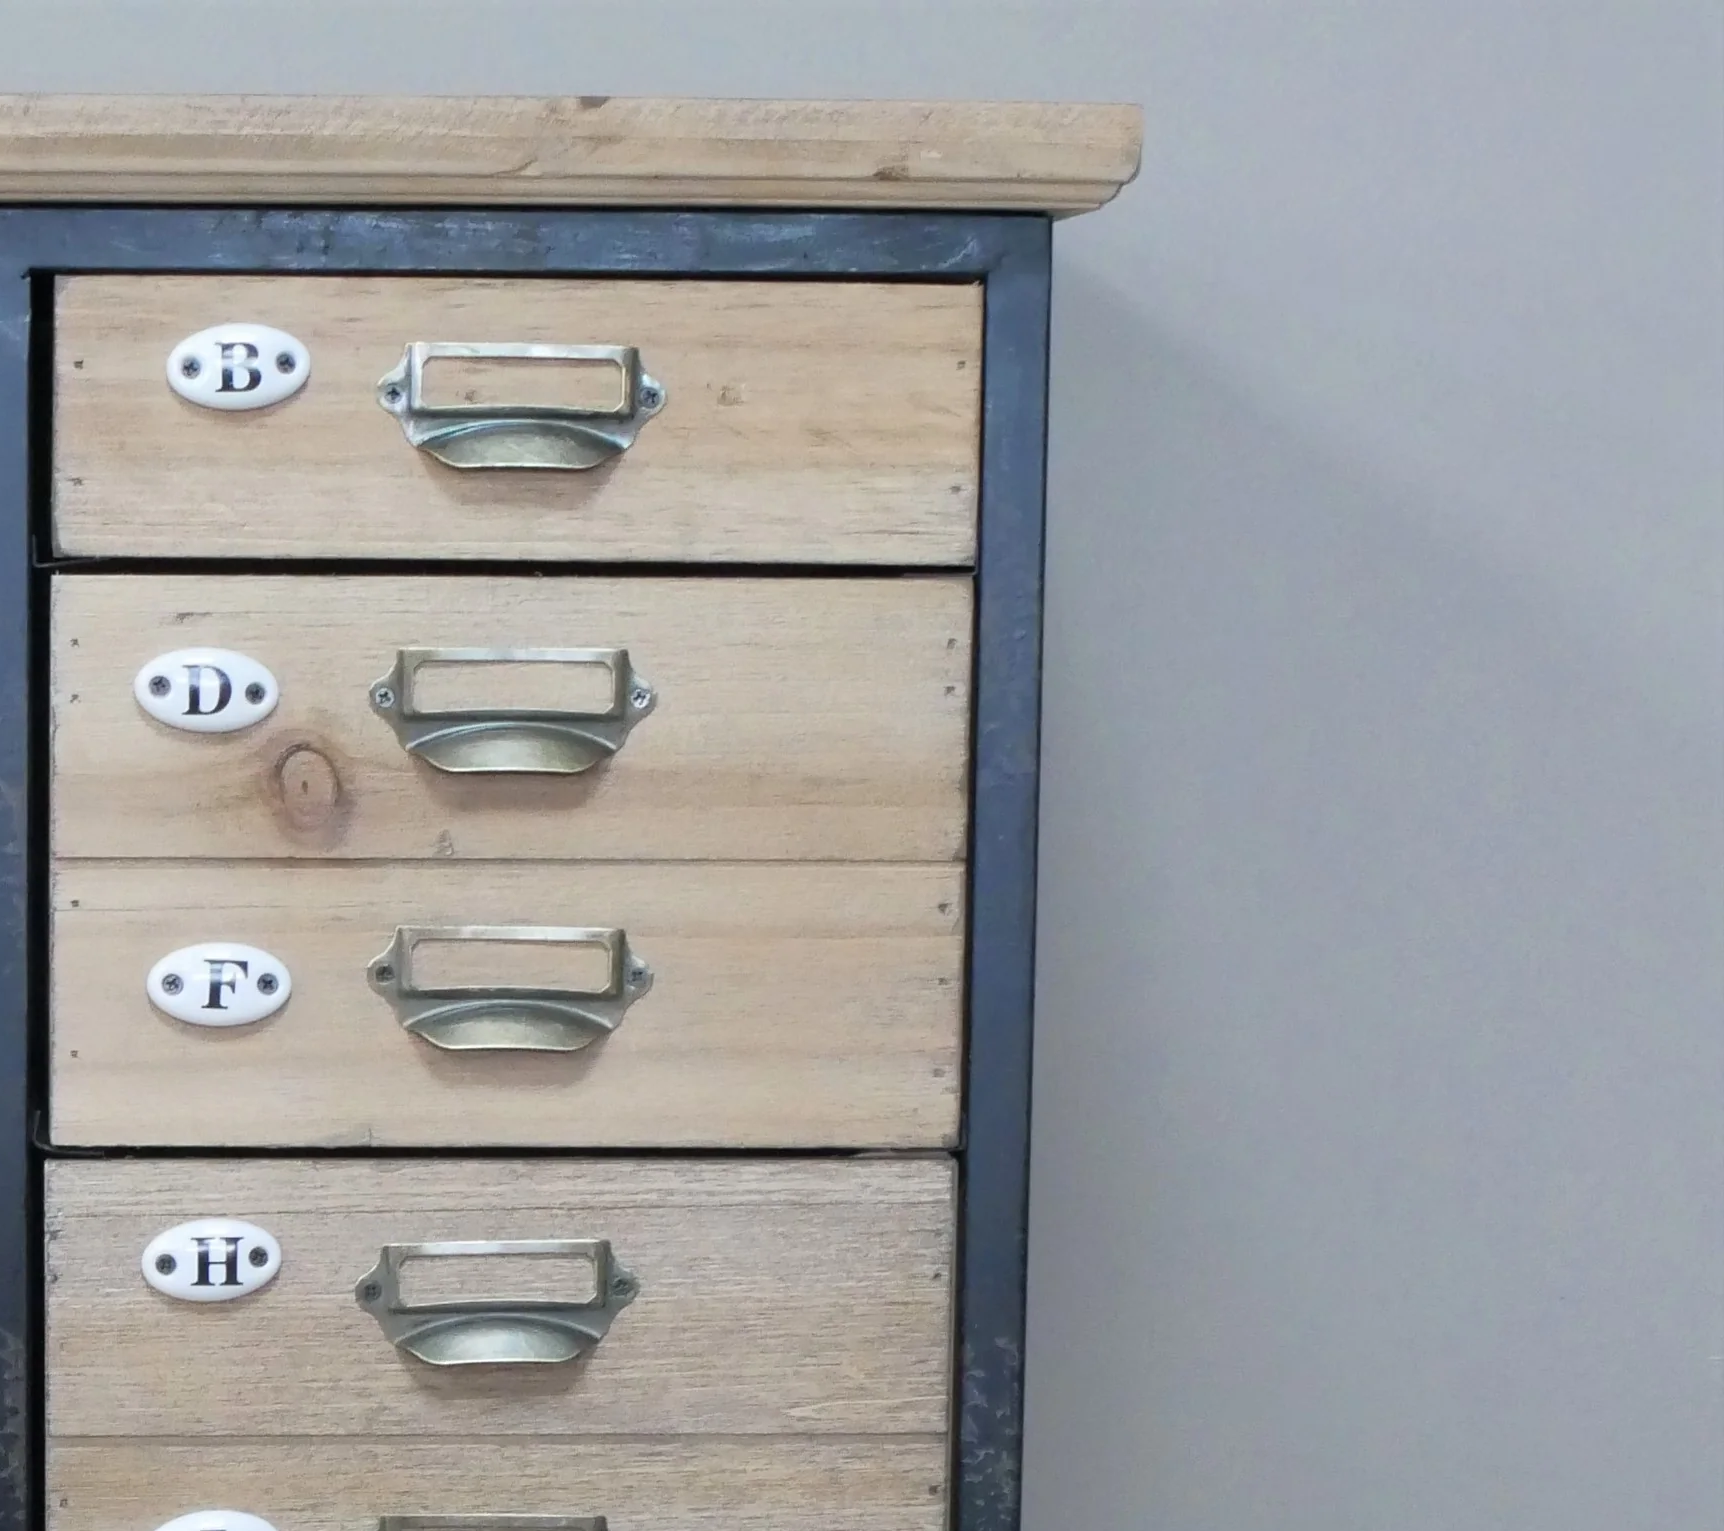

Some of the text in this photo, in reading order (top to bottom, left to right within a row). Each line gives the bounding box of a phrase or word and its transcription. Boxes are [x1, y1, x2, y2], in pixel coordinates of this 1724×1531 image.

[215, 341, 262, 393] B
[181, 664, 232, 715] D
[201, 959, 248, 1010] F
[191, 1237, 244, 1287] H
